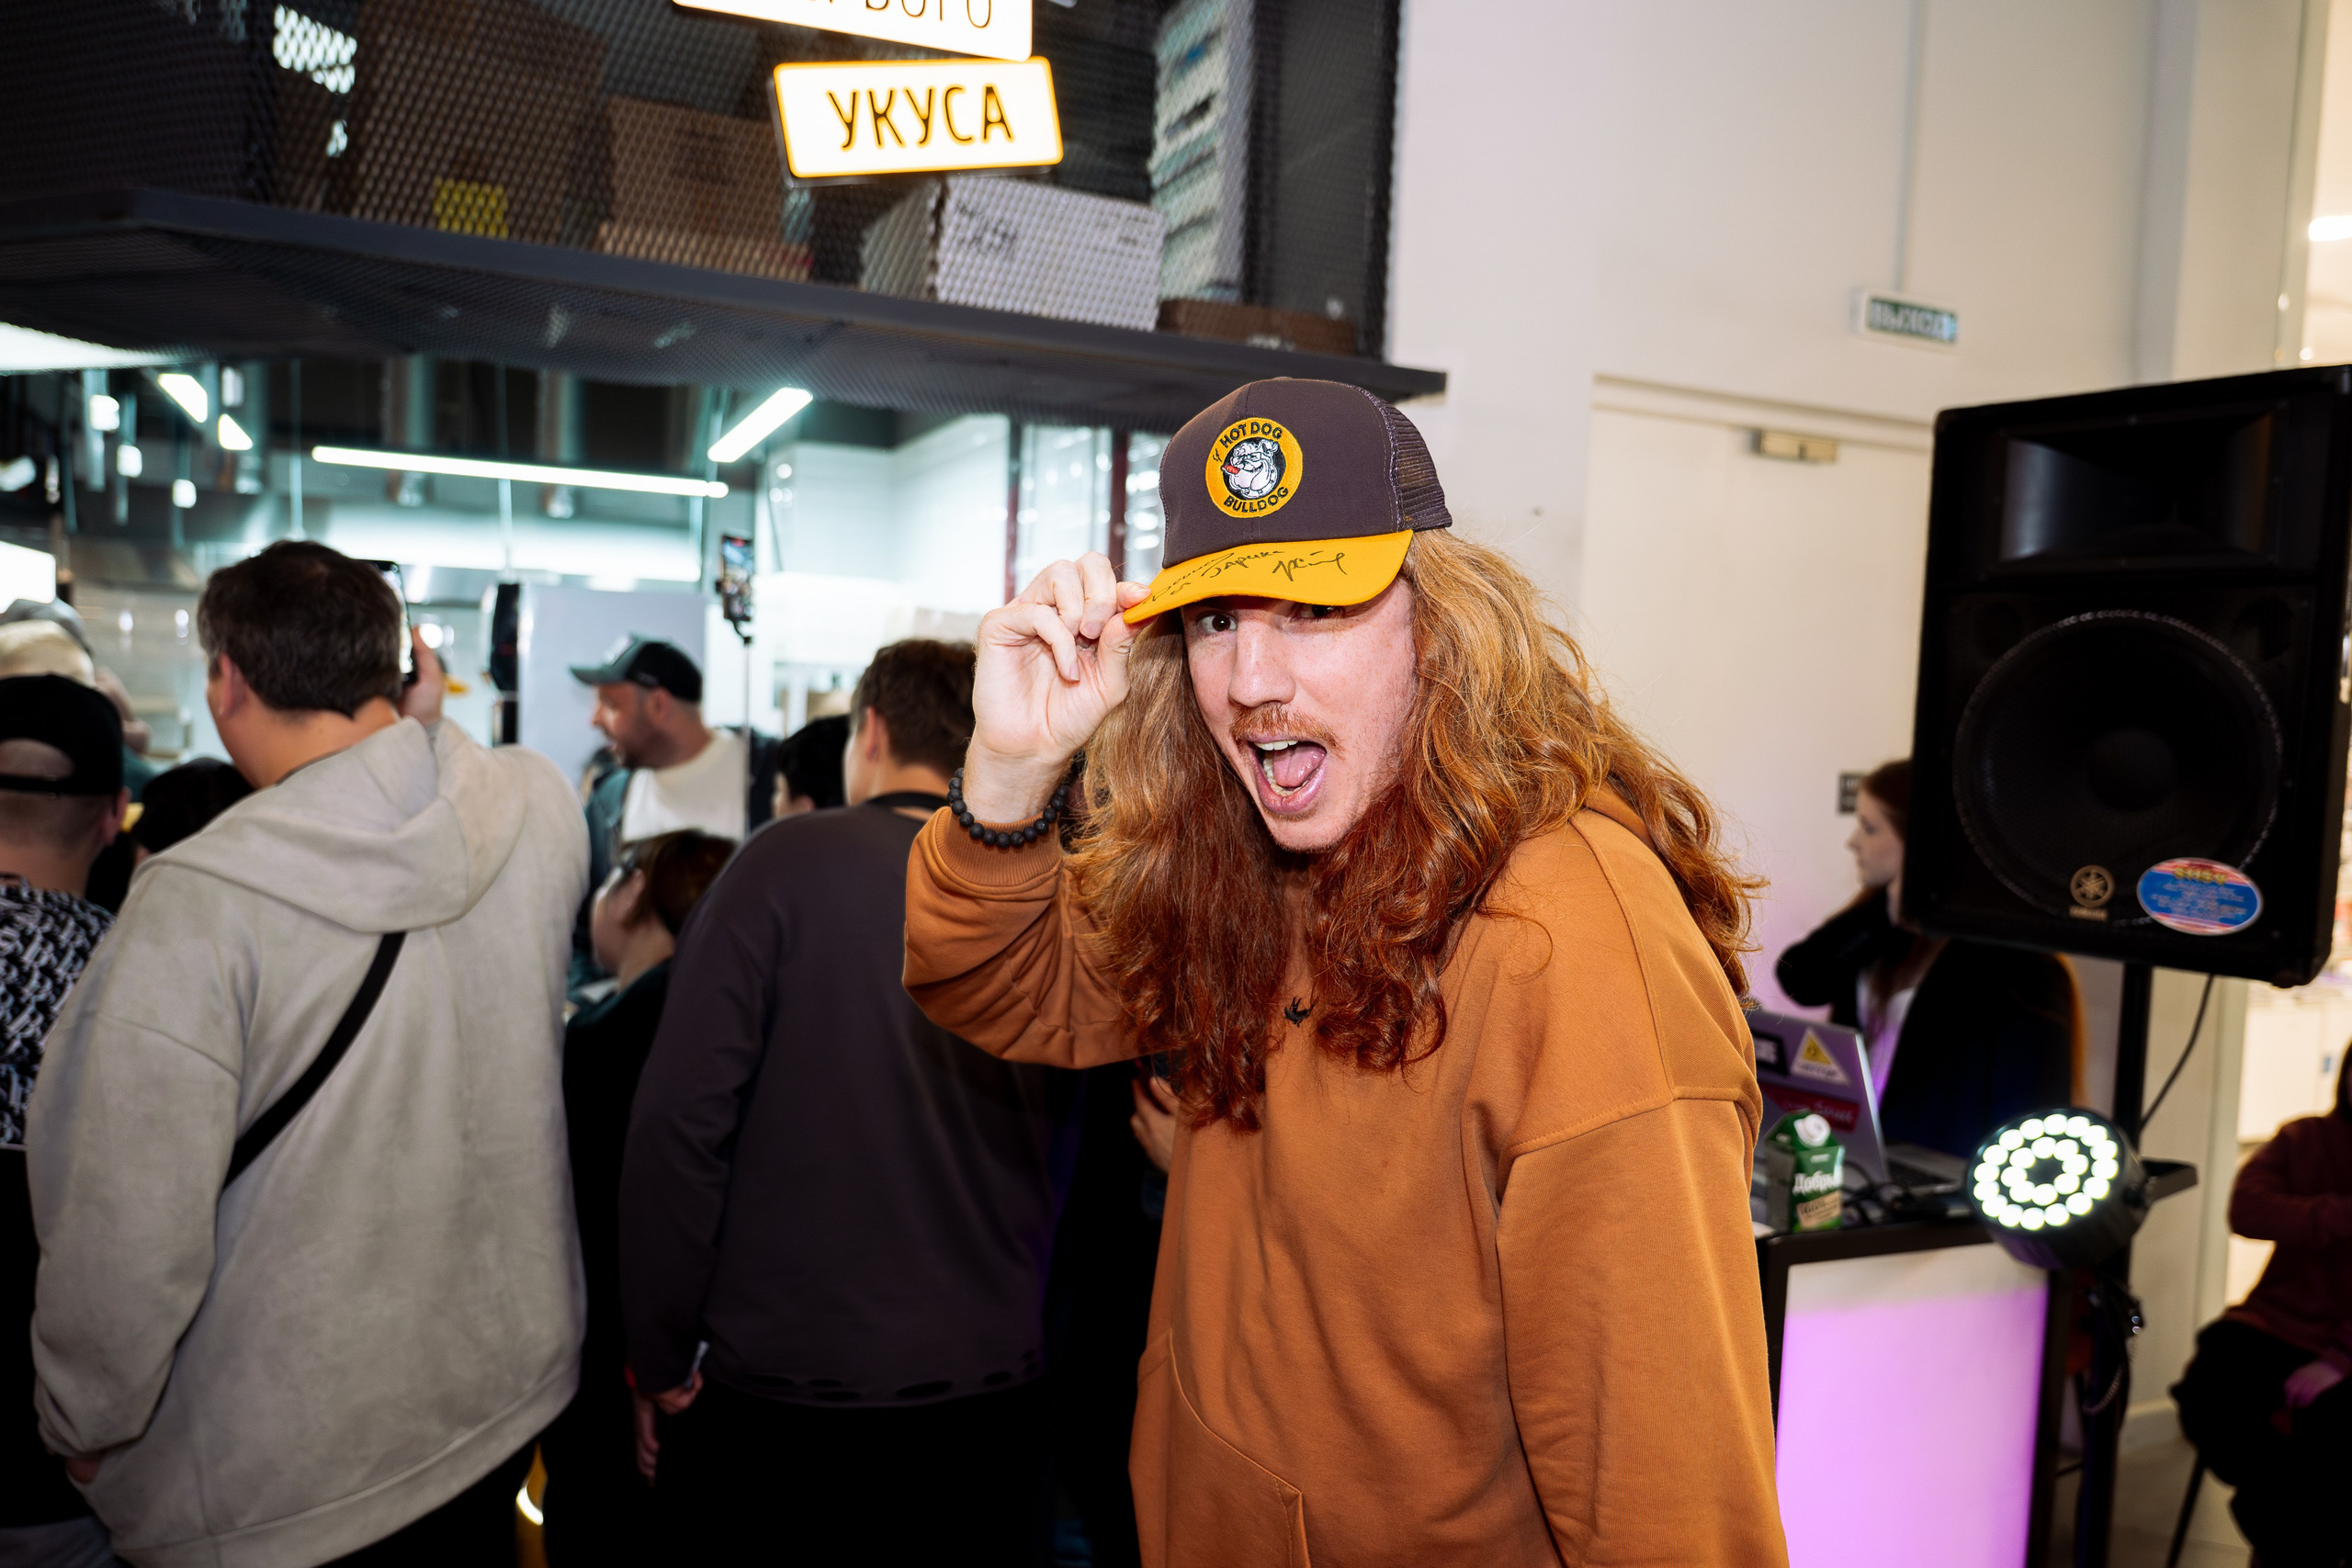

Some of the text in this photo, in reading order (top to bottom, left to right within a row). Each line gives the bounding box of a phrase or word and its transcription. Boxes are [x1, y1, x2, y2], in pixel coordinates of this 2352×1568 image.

[827, 85, 1013, 149] УКУСА
[1219, 421, 1283, 448] HOT DOG
[1223, 486, 1289, 513] BULLDOG
